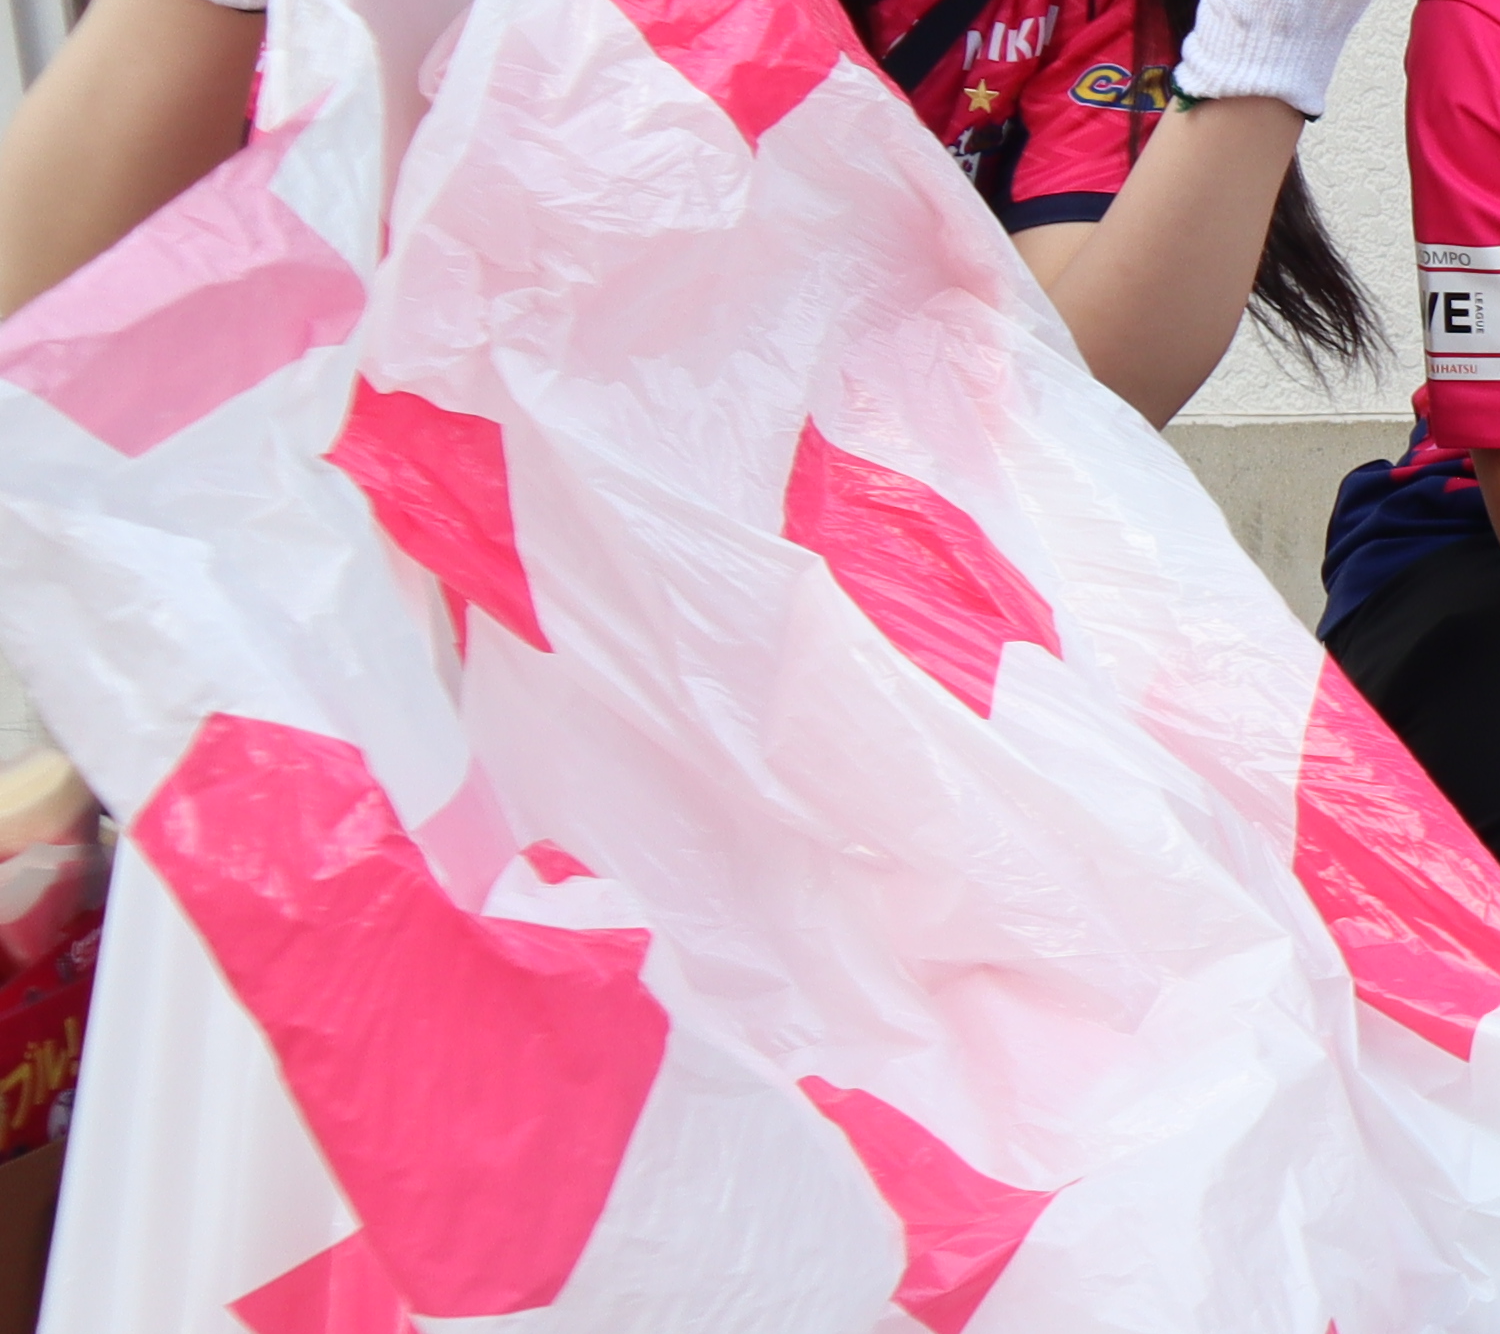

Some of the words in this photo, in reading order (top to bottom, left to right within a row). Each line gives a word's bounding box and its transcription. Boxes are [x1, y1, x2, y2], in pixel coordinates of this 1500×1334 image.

[1069, 64, 1173, 113] CA
[1421, 251, 1471, 266] OMPO
[1474, 292, 1485, 334] LEAGUE
[1430, 364, 1478, 375] AIHATSU
